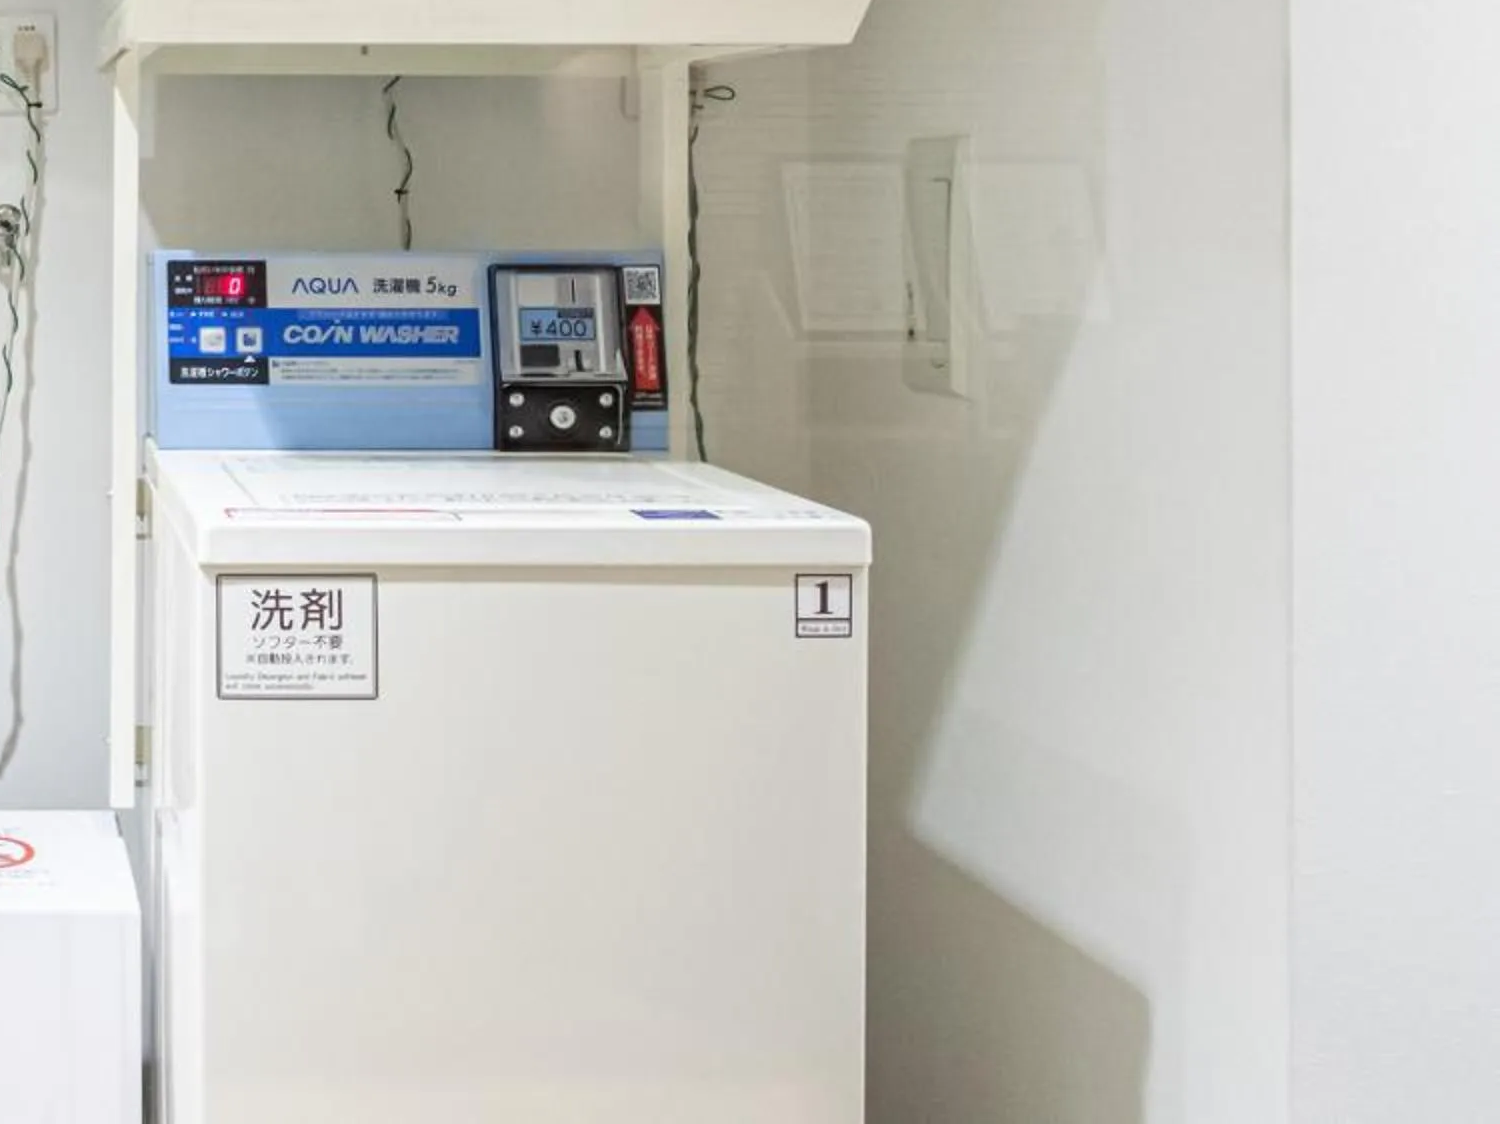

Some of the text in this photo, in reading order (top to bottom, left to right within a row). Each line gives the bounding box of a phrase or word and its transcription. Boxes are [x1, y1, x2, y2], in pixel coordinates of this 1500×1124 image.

[292, 277, 359, 294] AQUA
[372, 276, 457, 297] 洗濯機 5kg
[284, 319, 459, 344] COIN WASHER
[531, 320, 587, 338] ¥400
[813, 580, 834, 614] 1
[251, 588, 344, 630] 洗剤
[252, 635, 343, 650] ソフター不要
